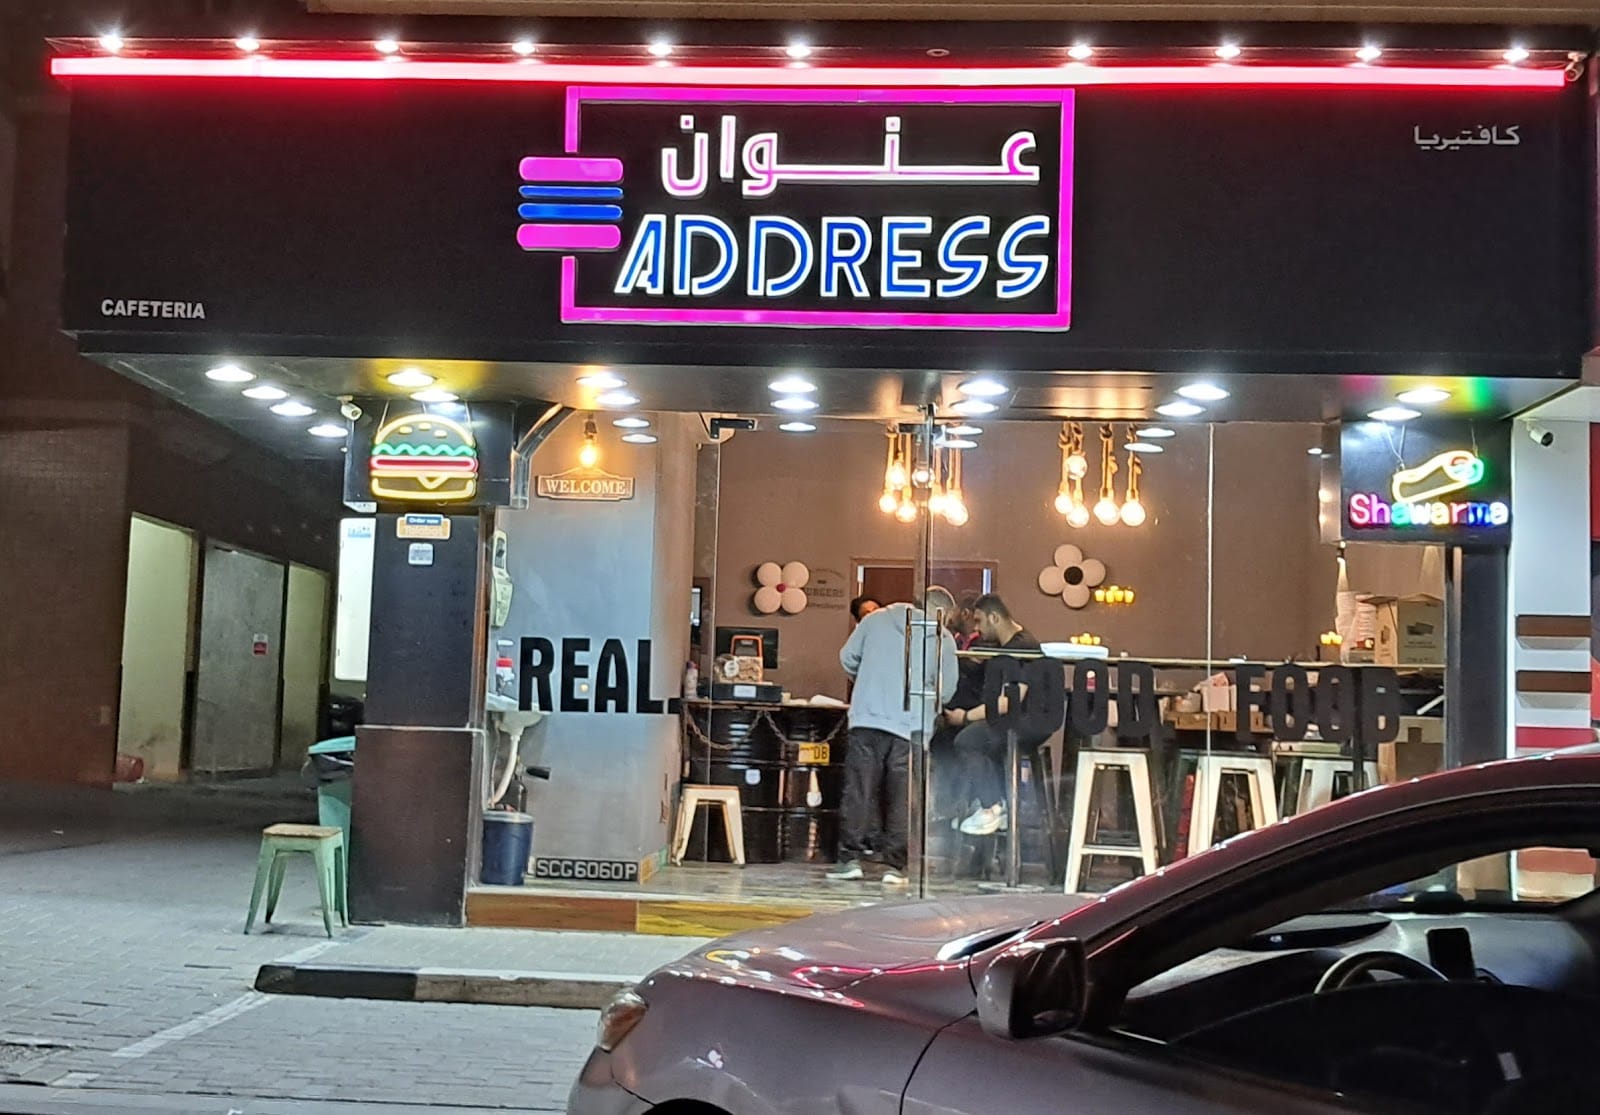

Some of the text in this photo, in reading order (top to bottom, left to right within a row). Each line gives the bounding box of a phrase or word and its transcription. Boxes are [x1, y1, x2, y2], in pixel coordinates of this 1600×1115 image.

[1413, 124, 1520, 150] كافتيريا
[661, 114, 1040, 197] عنوان
[614, 213, 1050, 299] ADDRESS
[101, 299, 206, 319] CAFETERIA
[545, 479, 627, 495] WELCOME
[1350, 493, 1509, 526] Shawarma
[1237, 664, 1399, 743] FOOD
[537, 859, 638, 880] SCG6060P
